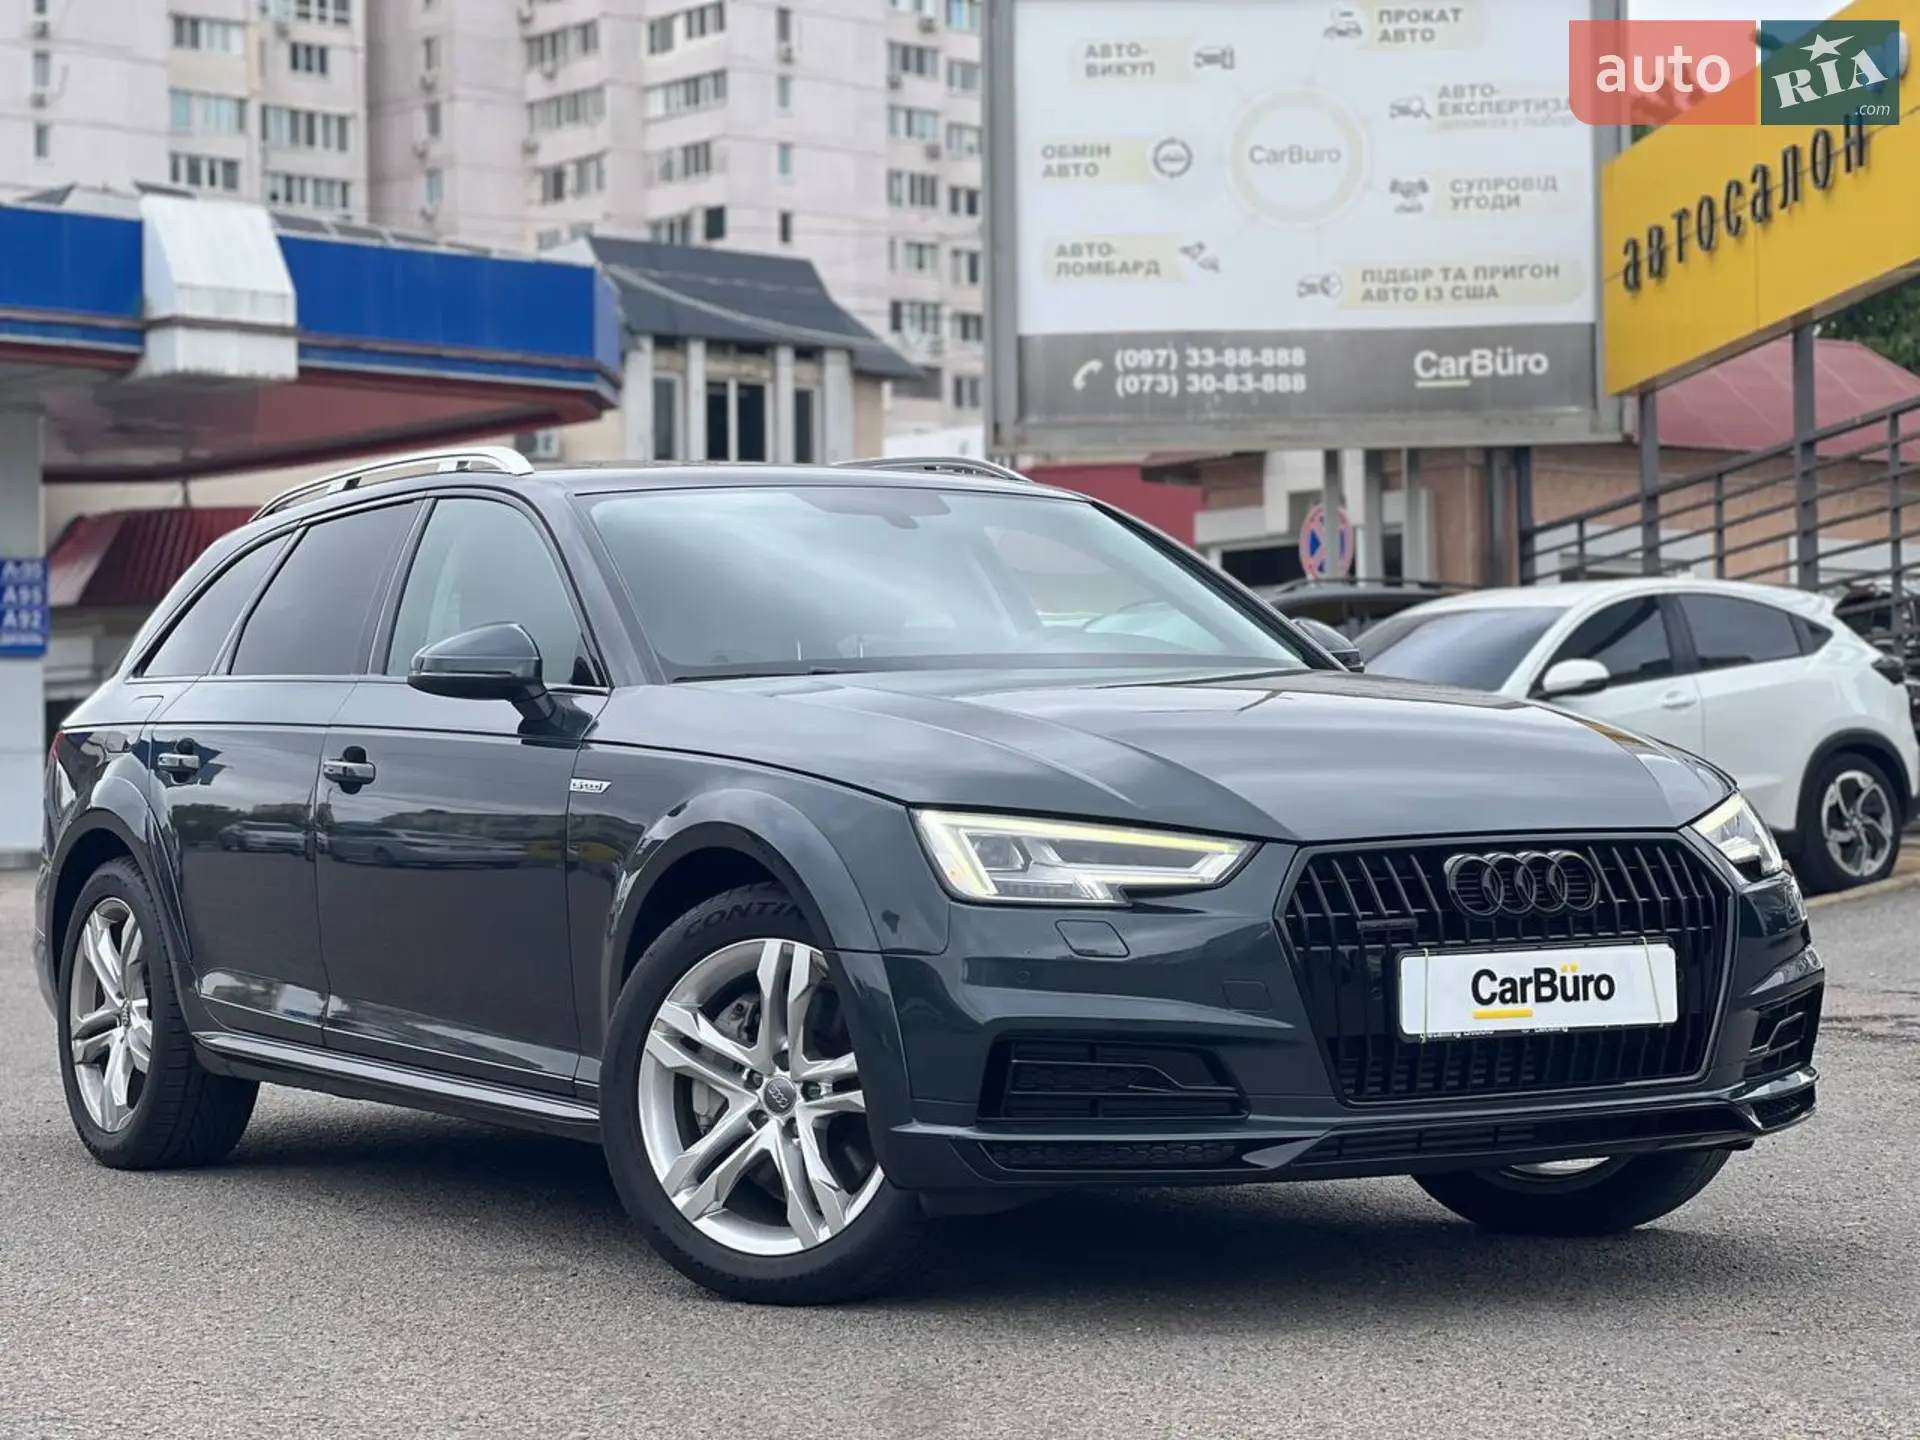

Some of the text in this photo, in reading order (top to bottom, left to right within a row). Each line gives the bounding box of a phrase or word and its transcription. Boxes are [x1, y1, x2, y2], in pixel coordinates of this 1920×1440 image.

[1378, 8, 1462, 25] ПРОКАТ
[1378, 28, 1436, 43] АВТО
[1085, 42, 1149, 59] АВТО-
[1085, 61, 1156, 78] ВИКУП
[1437, 83, 1501, 99] АВТО-
[1041, 143, 1112, 160] ОБМІН
[1041, 162, 1100, 178] АВТО
[1450, 175, 1558, 194] СУПРОВІД
[1451, 194, 1521, 211] УГОДИ
[1056, 241, 1118, 258] АВТО-
[1056, 259, 1162, 278] ЛОМБАРД
[1361, 263, 1560, 284] ПІДБІР ТА ПРИГОН
[1361, 286, 1418, 303] АВТО
[1450, 284, 1501, 300] США
[1115, 348, 1179, 372] (097)
[1413, 346, 1550, 379] CarBüro
[1115, 373, 1180, 398] (073)
[1471, 961, 1616, 1006] CarBüro
